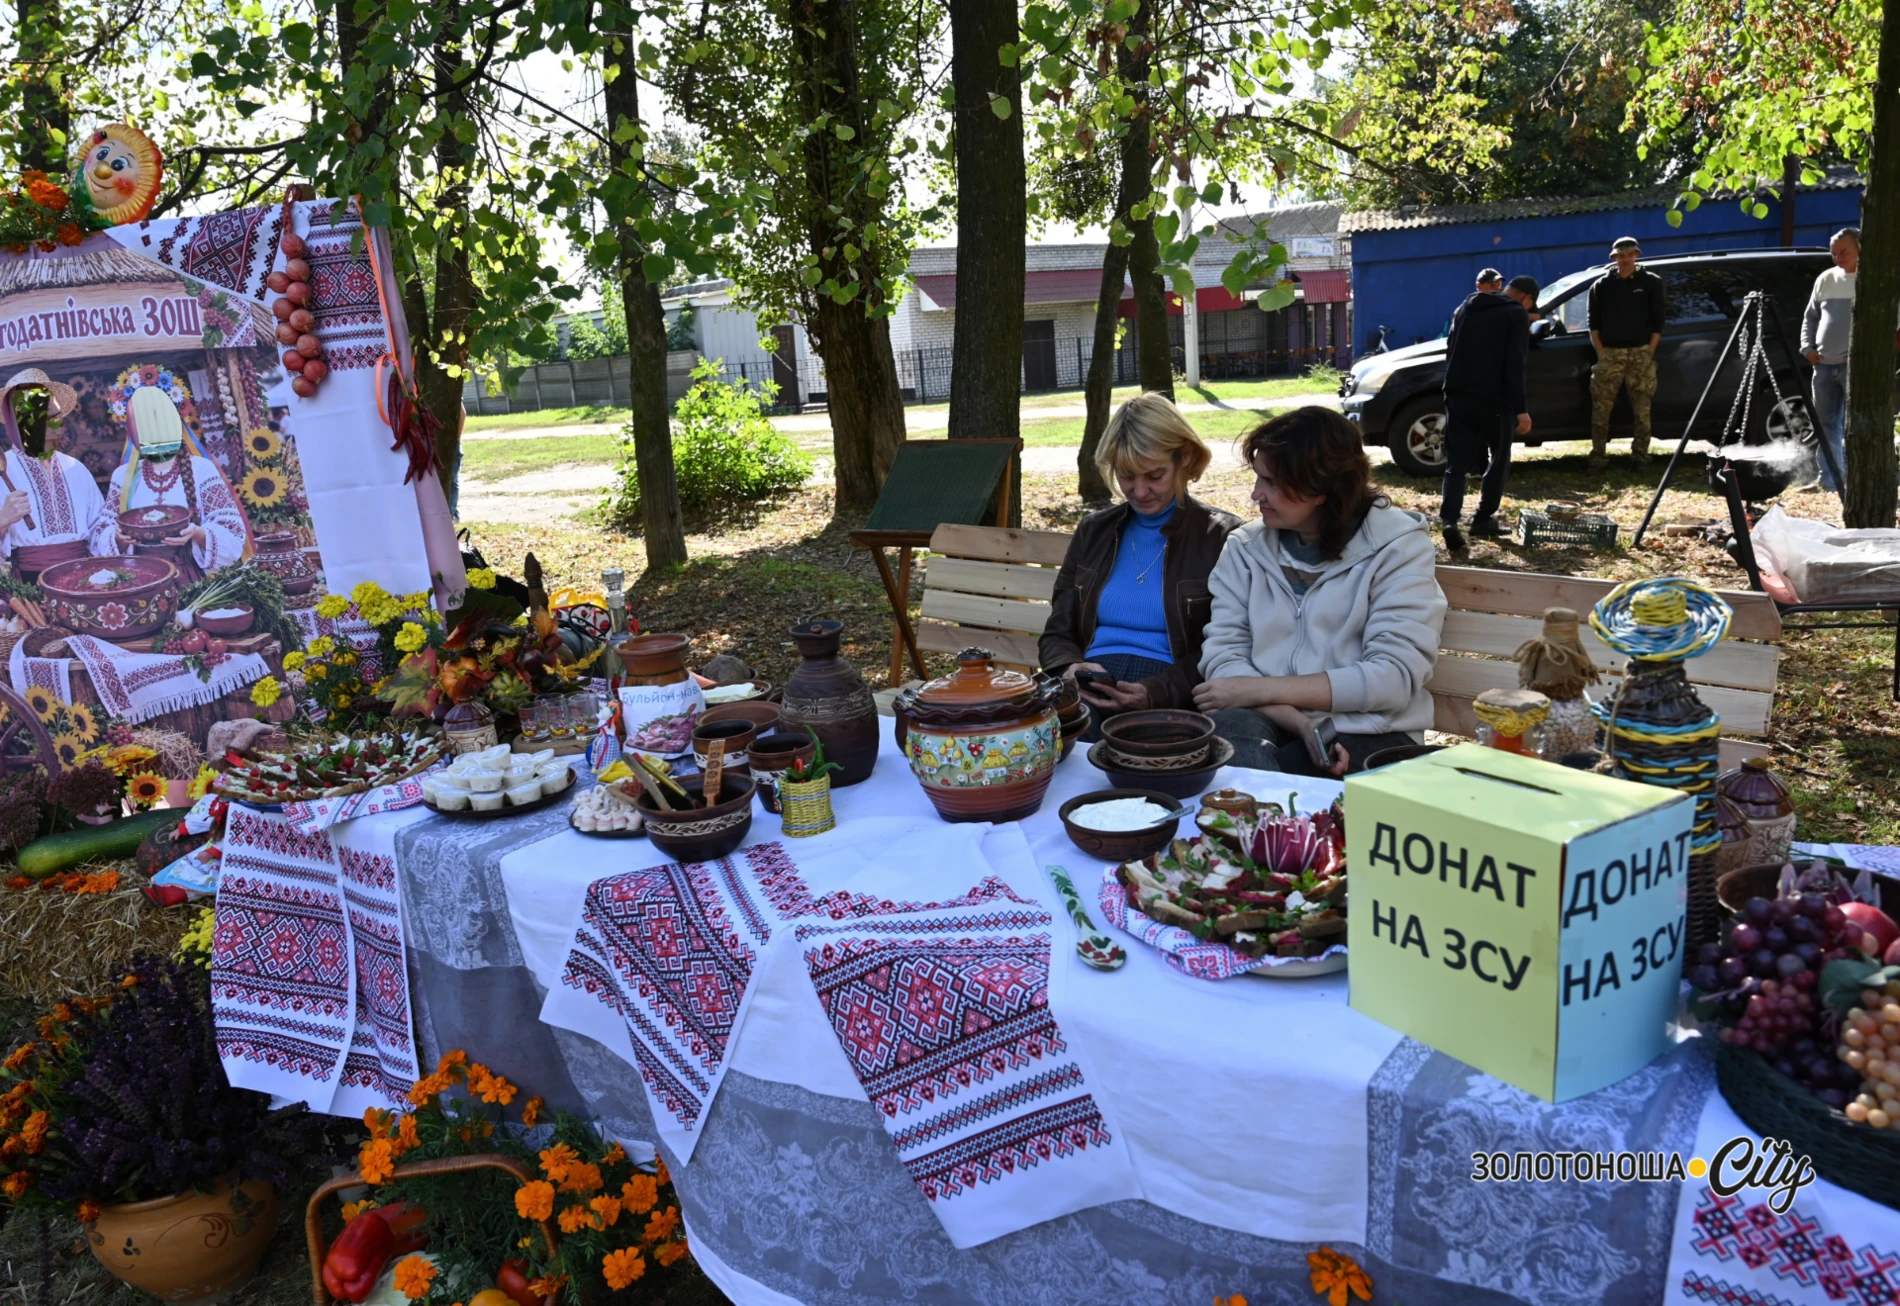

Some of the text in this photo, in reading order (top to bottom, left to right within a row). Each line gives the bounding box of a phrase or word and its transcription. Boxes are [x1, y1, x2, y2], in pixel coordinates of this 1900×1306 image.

[141, 297, 203, 336] ЗОШ
[1369, 822, 1537, 909] ДОНАТ
[1562, 830, 1691, 929] ДОНАТ
[1372, 899, 1532, 991] НА ЗСУ
[1562, 915, 1685, 1007] НА ЗСУ
